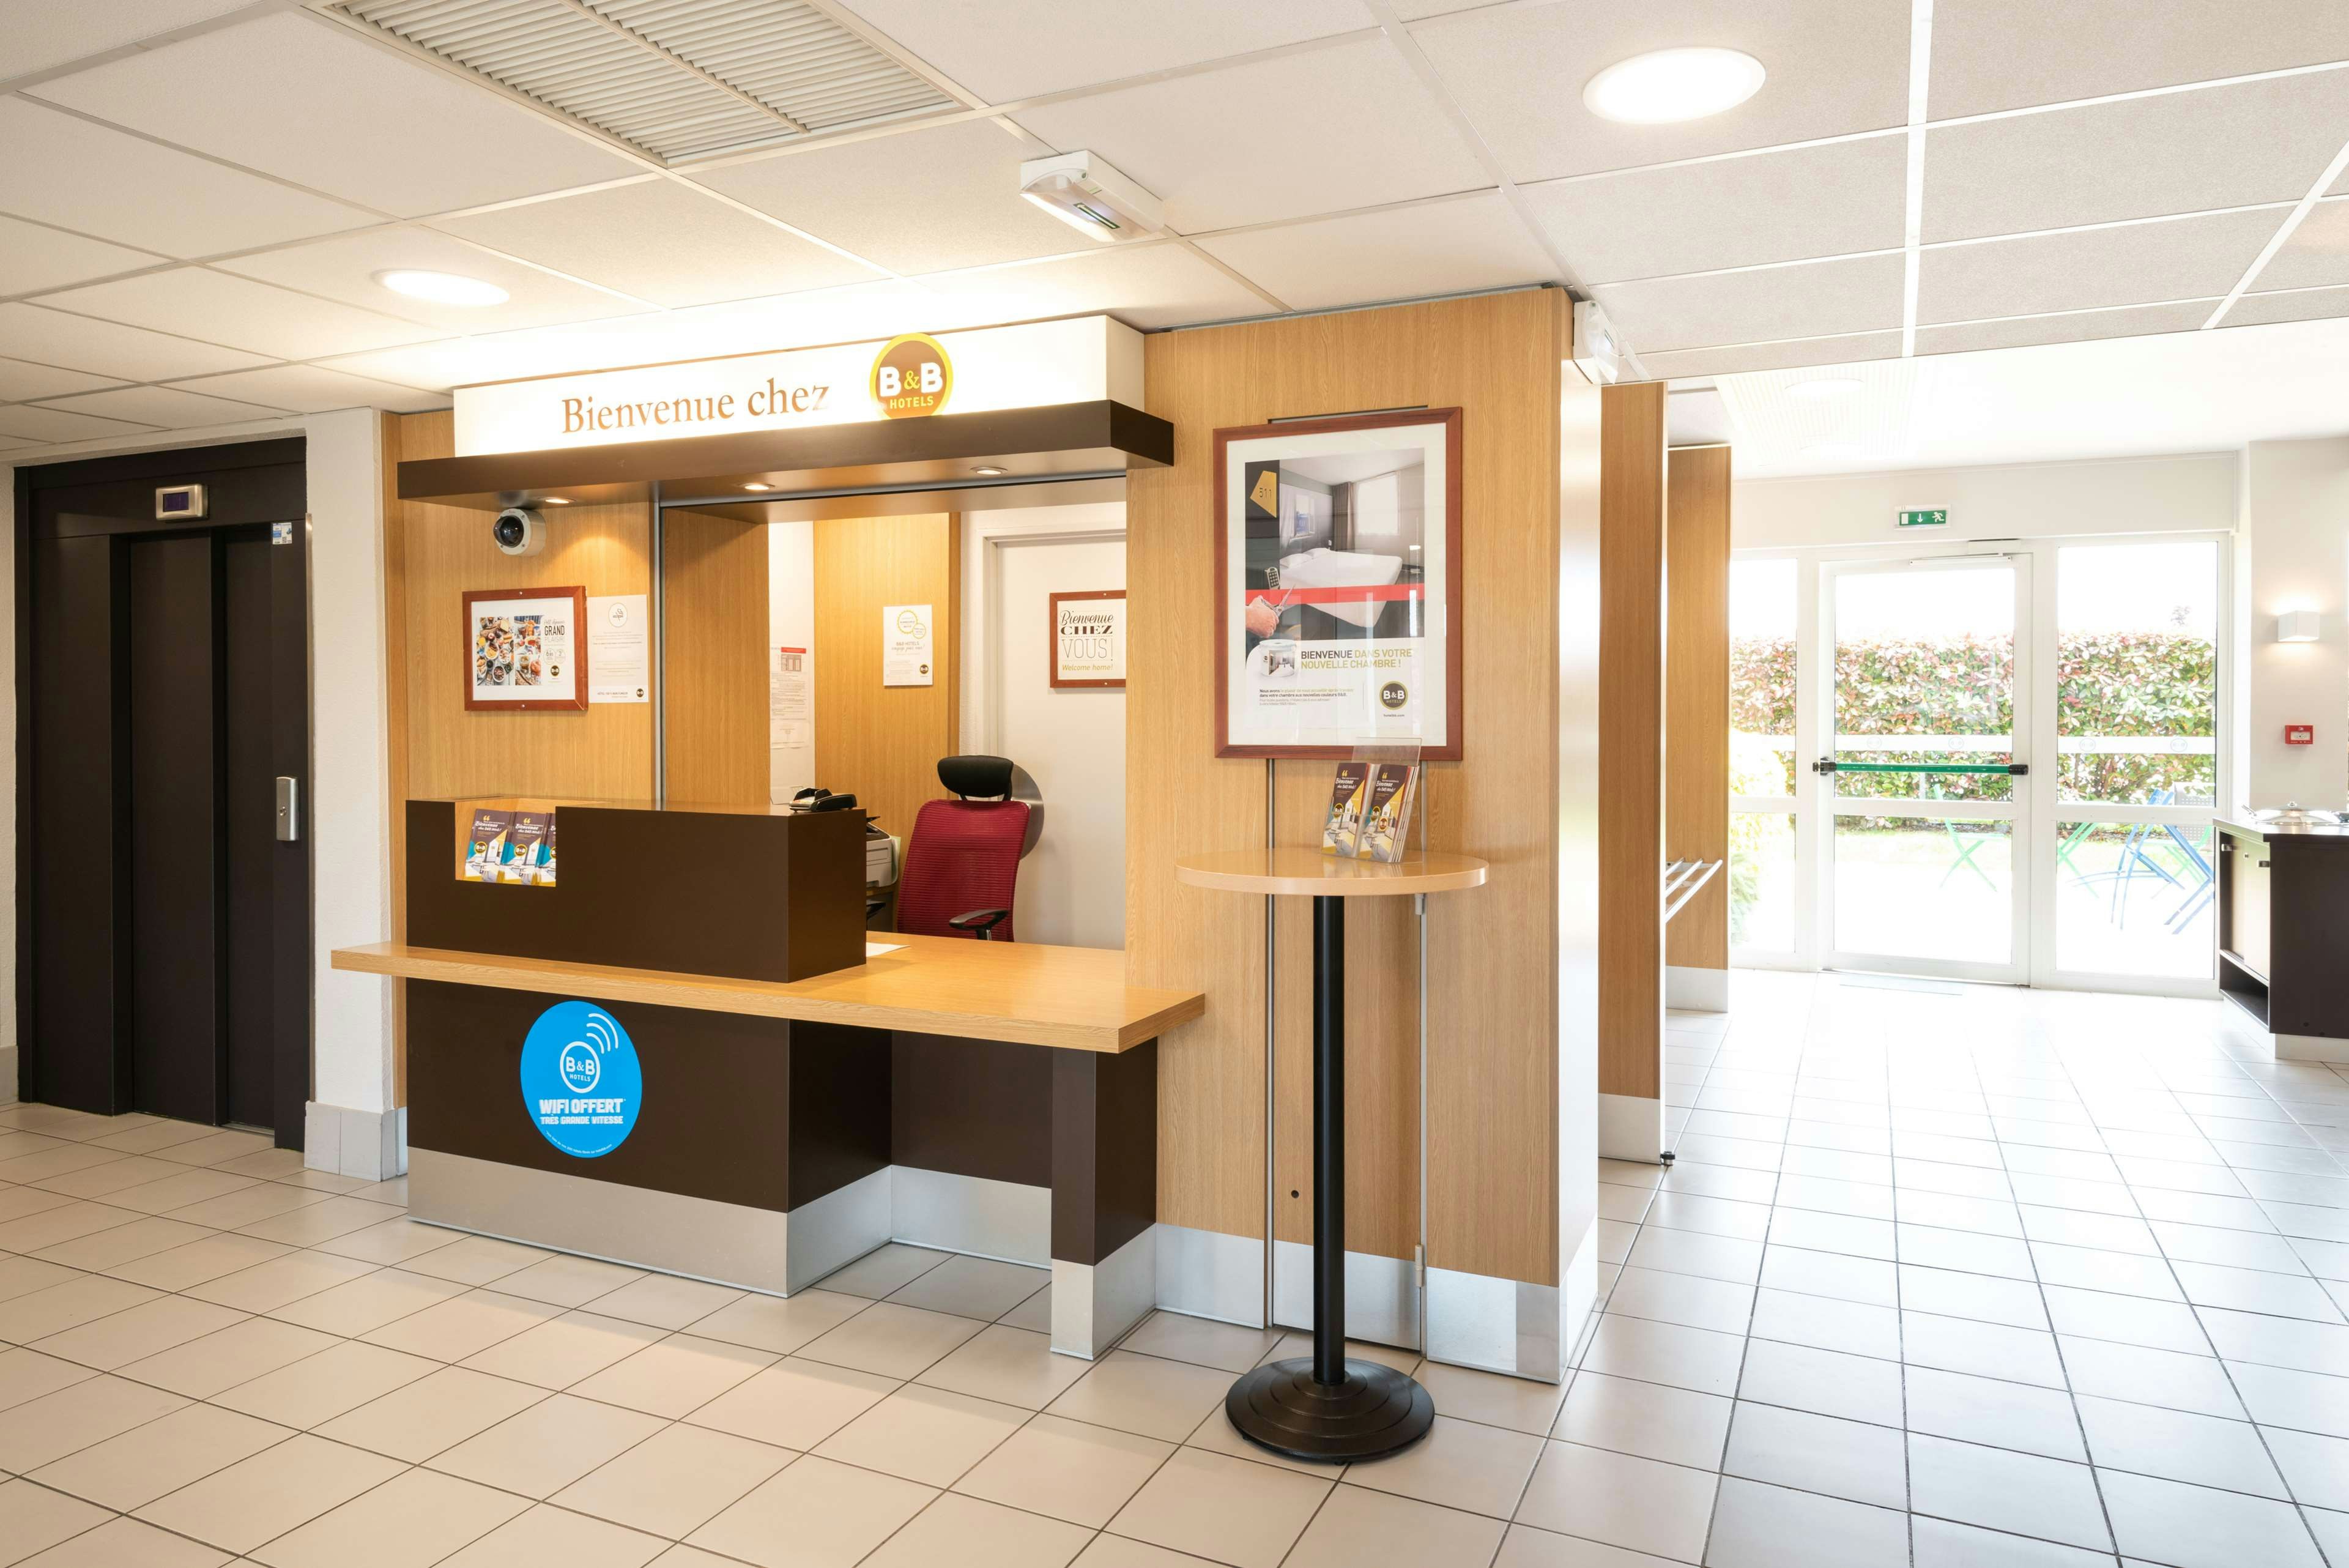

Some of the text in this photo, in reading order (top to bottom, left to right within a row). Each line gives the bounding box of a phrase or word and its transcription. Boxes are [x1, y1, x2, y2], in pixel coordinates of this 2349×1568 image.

[879, 362, 943, 397] B&B
[562, 378, 830, 434] Bienvenue chez
[889, 395, 934, 409] HOTELS
[1061, 609, 1114, 626] Bienvenue
[544, 625, 565, 636] GRAND
[1061, 625, 1113, 635] CHEZ
[1301, 650, 1353, 660] BIENVENUE
[1382, 648, 1412, 658] VOTRE
[1301, 660, 1348, 669] NOUVELLE
[1350, 659, 1396, 669] CHAMBRE
[1383, 690, 1405, 699] B&B
[566, 1057, 595, 1076] B&B
[570, 1073, 591, 1082] HOTELS
[538, 1099, 570, 1114] WIFI
[539, 1113, 624, 1125] TRÈS GRANDE VITESSE
